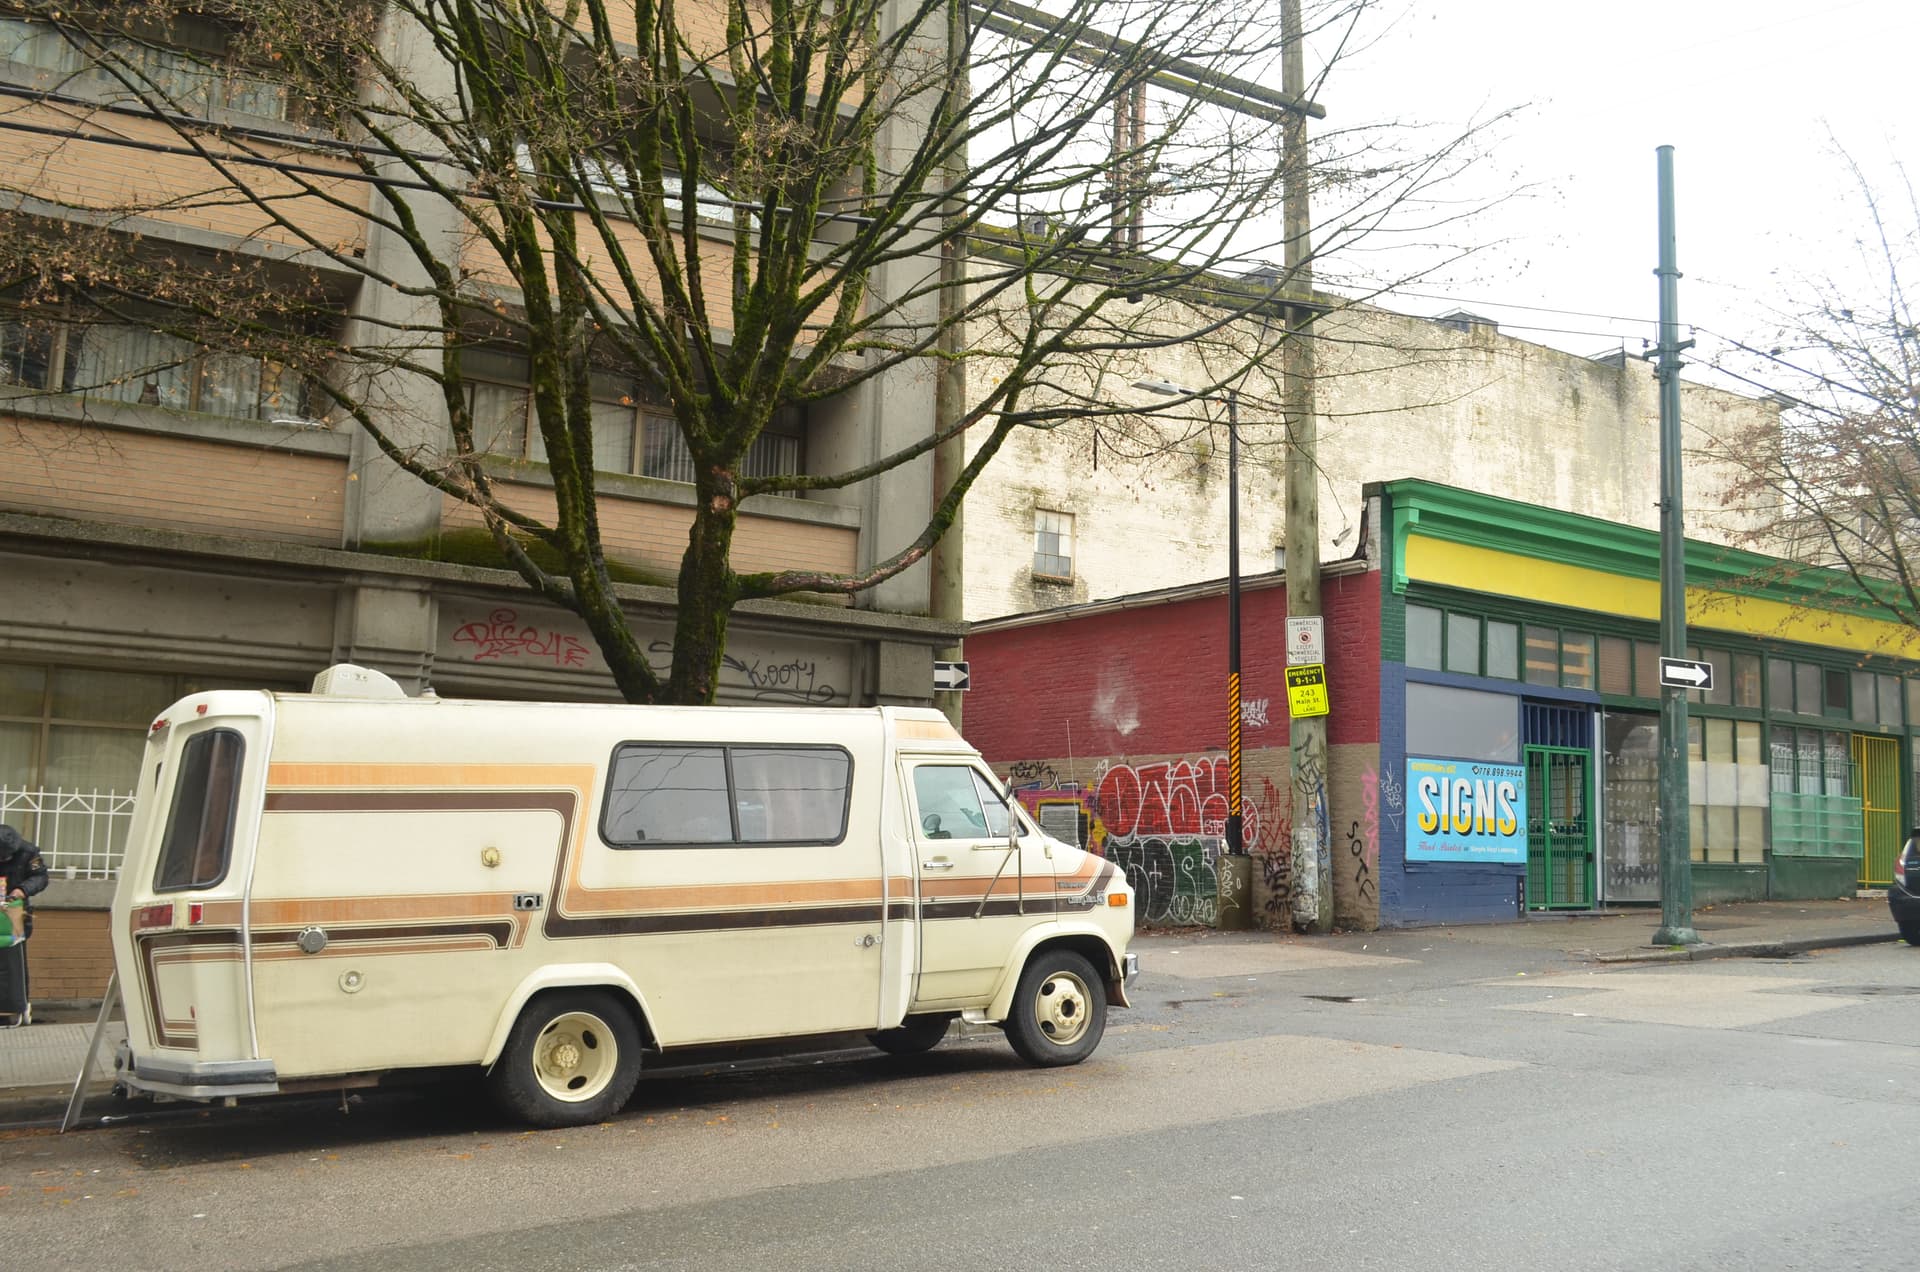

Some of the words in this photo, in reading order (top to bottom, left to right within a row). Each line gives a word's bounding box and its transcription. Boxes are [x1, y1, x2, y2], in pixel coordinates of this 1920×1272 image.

[1288, 668, 1321, 677] EMERGENCY
[1295, 676, 1317, 685] 9-1-1
[1300, 689, 1315, 697] 243
[1418, 776, 1517, 837] SIGNS
